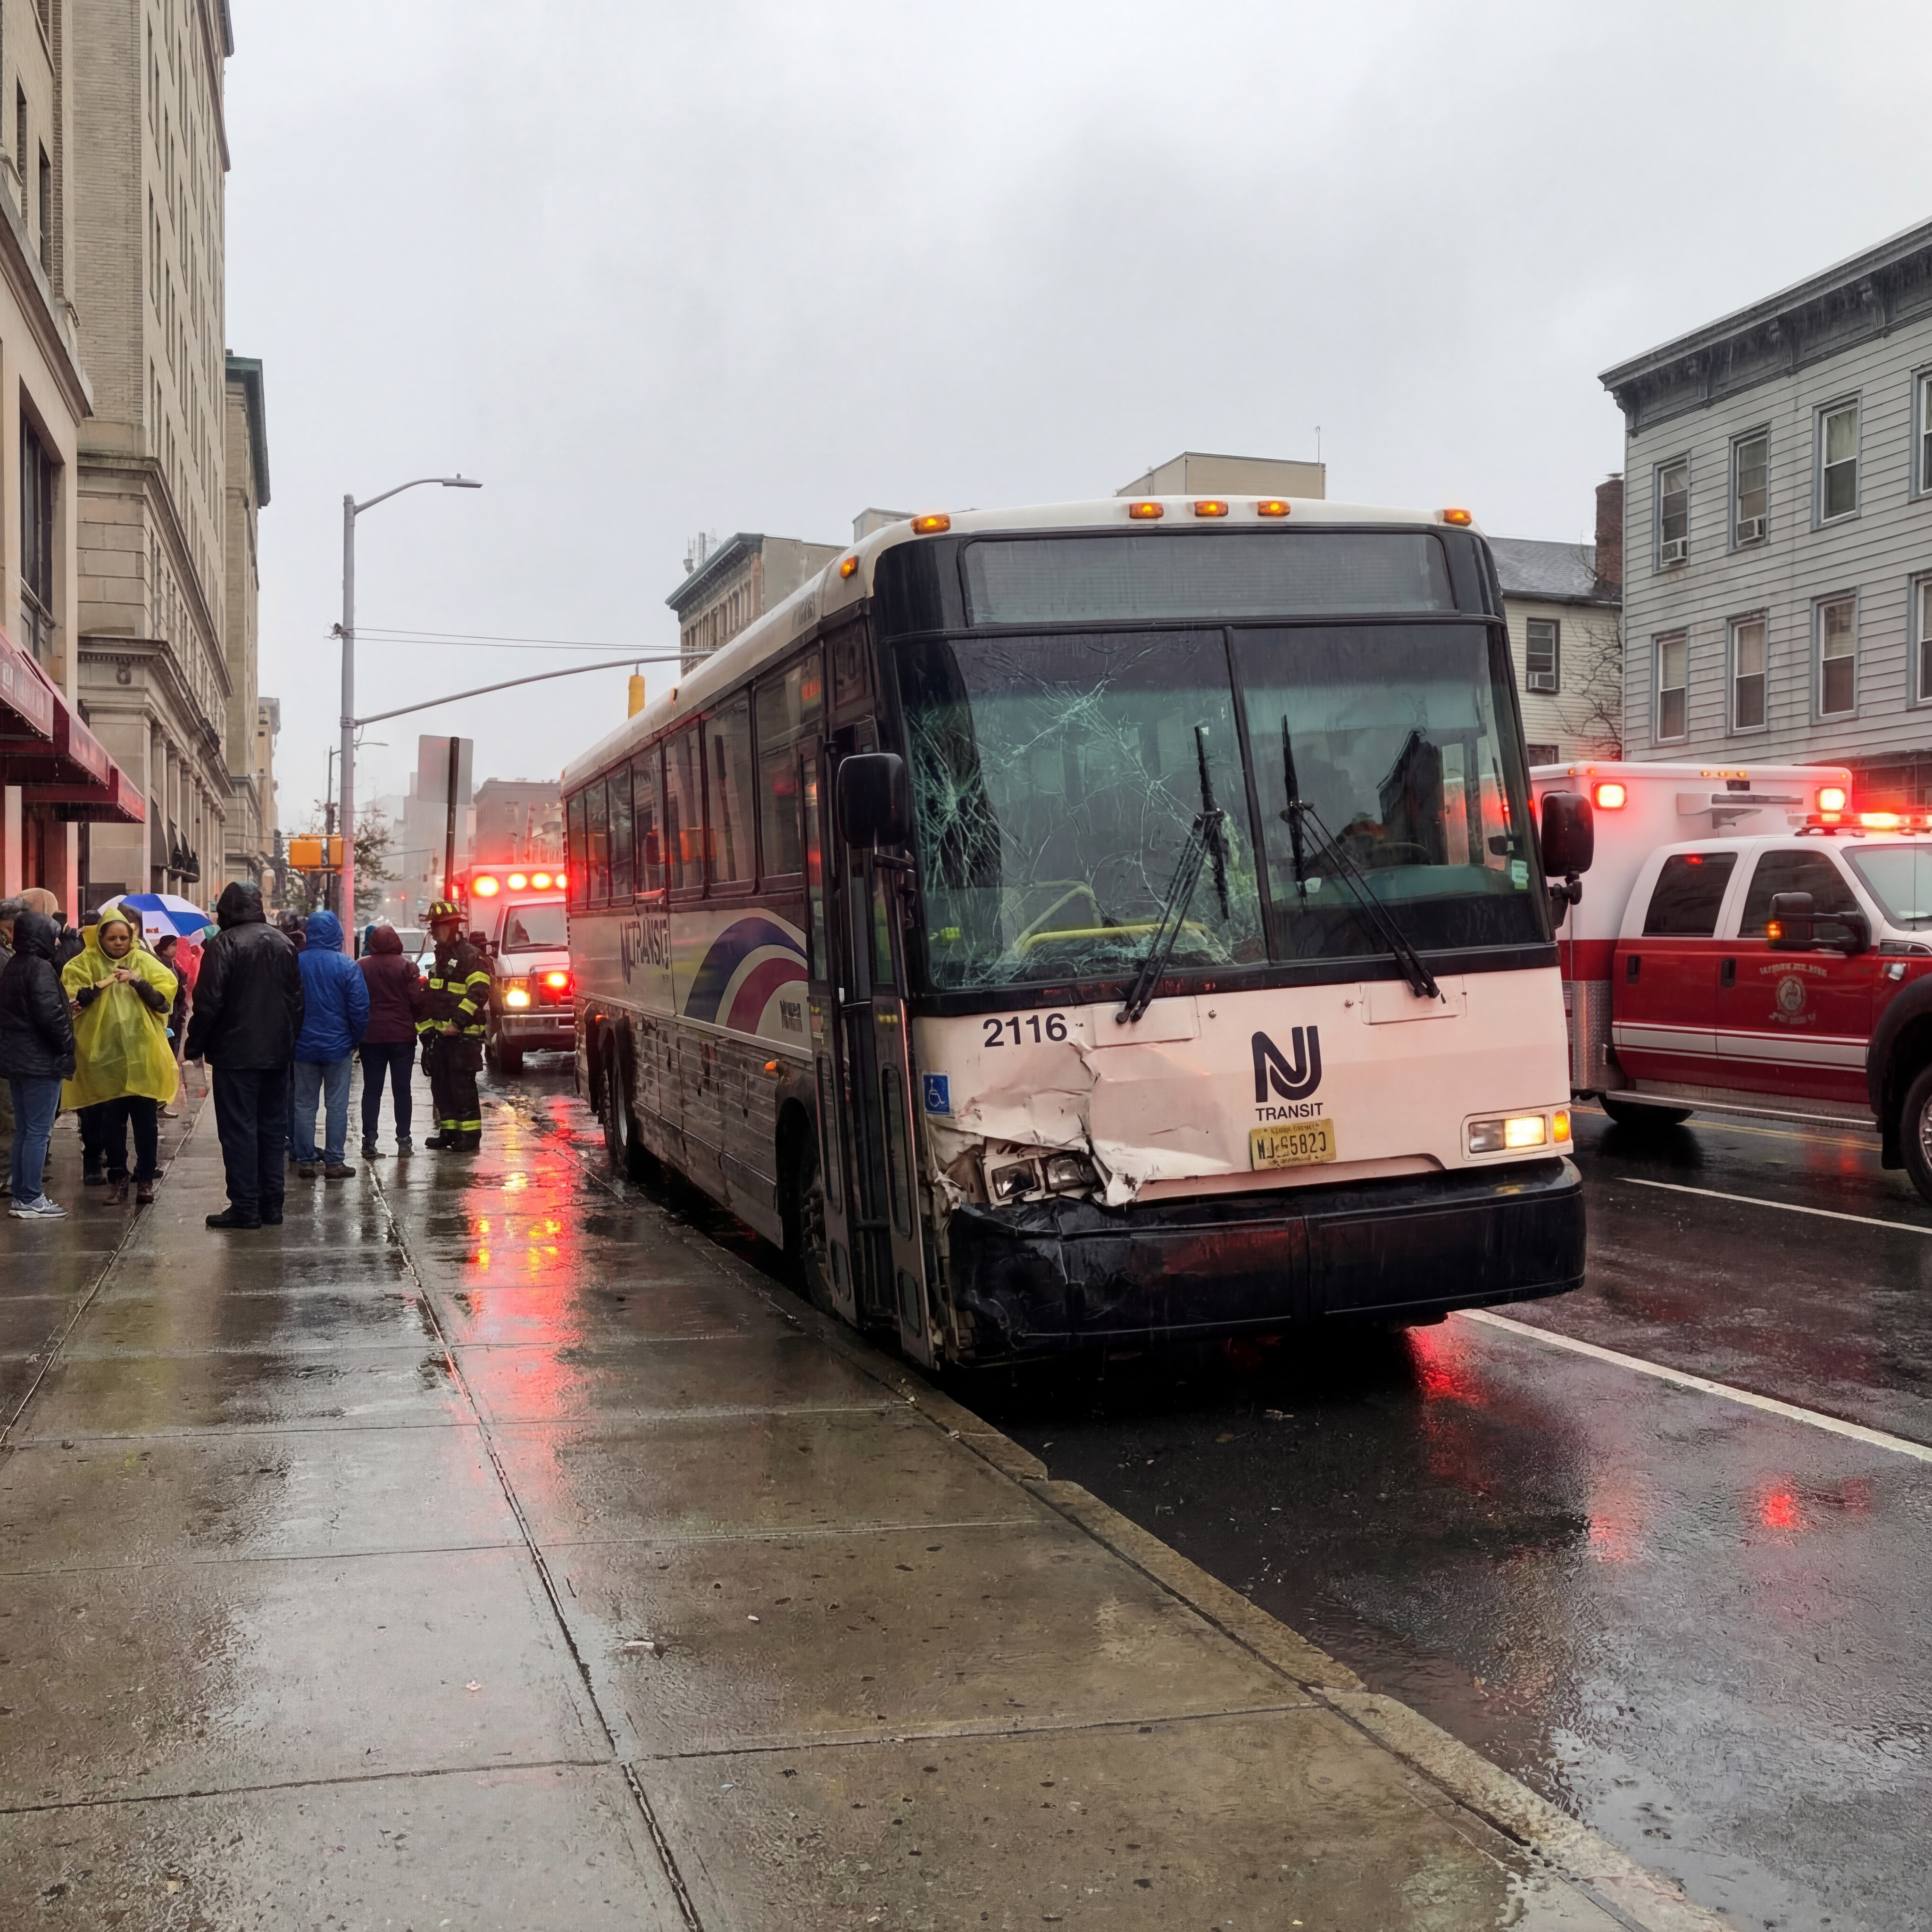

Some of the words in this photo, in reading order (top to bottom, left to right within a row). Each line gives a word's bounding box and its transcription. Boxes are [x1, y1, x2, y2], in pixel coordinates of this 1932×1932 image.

[983, 1013, 1067, 1048] 2116
[1251, 1025, 1322, 1103] NJ
[1255, 1102, 1323, 1121] TRANSIT
